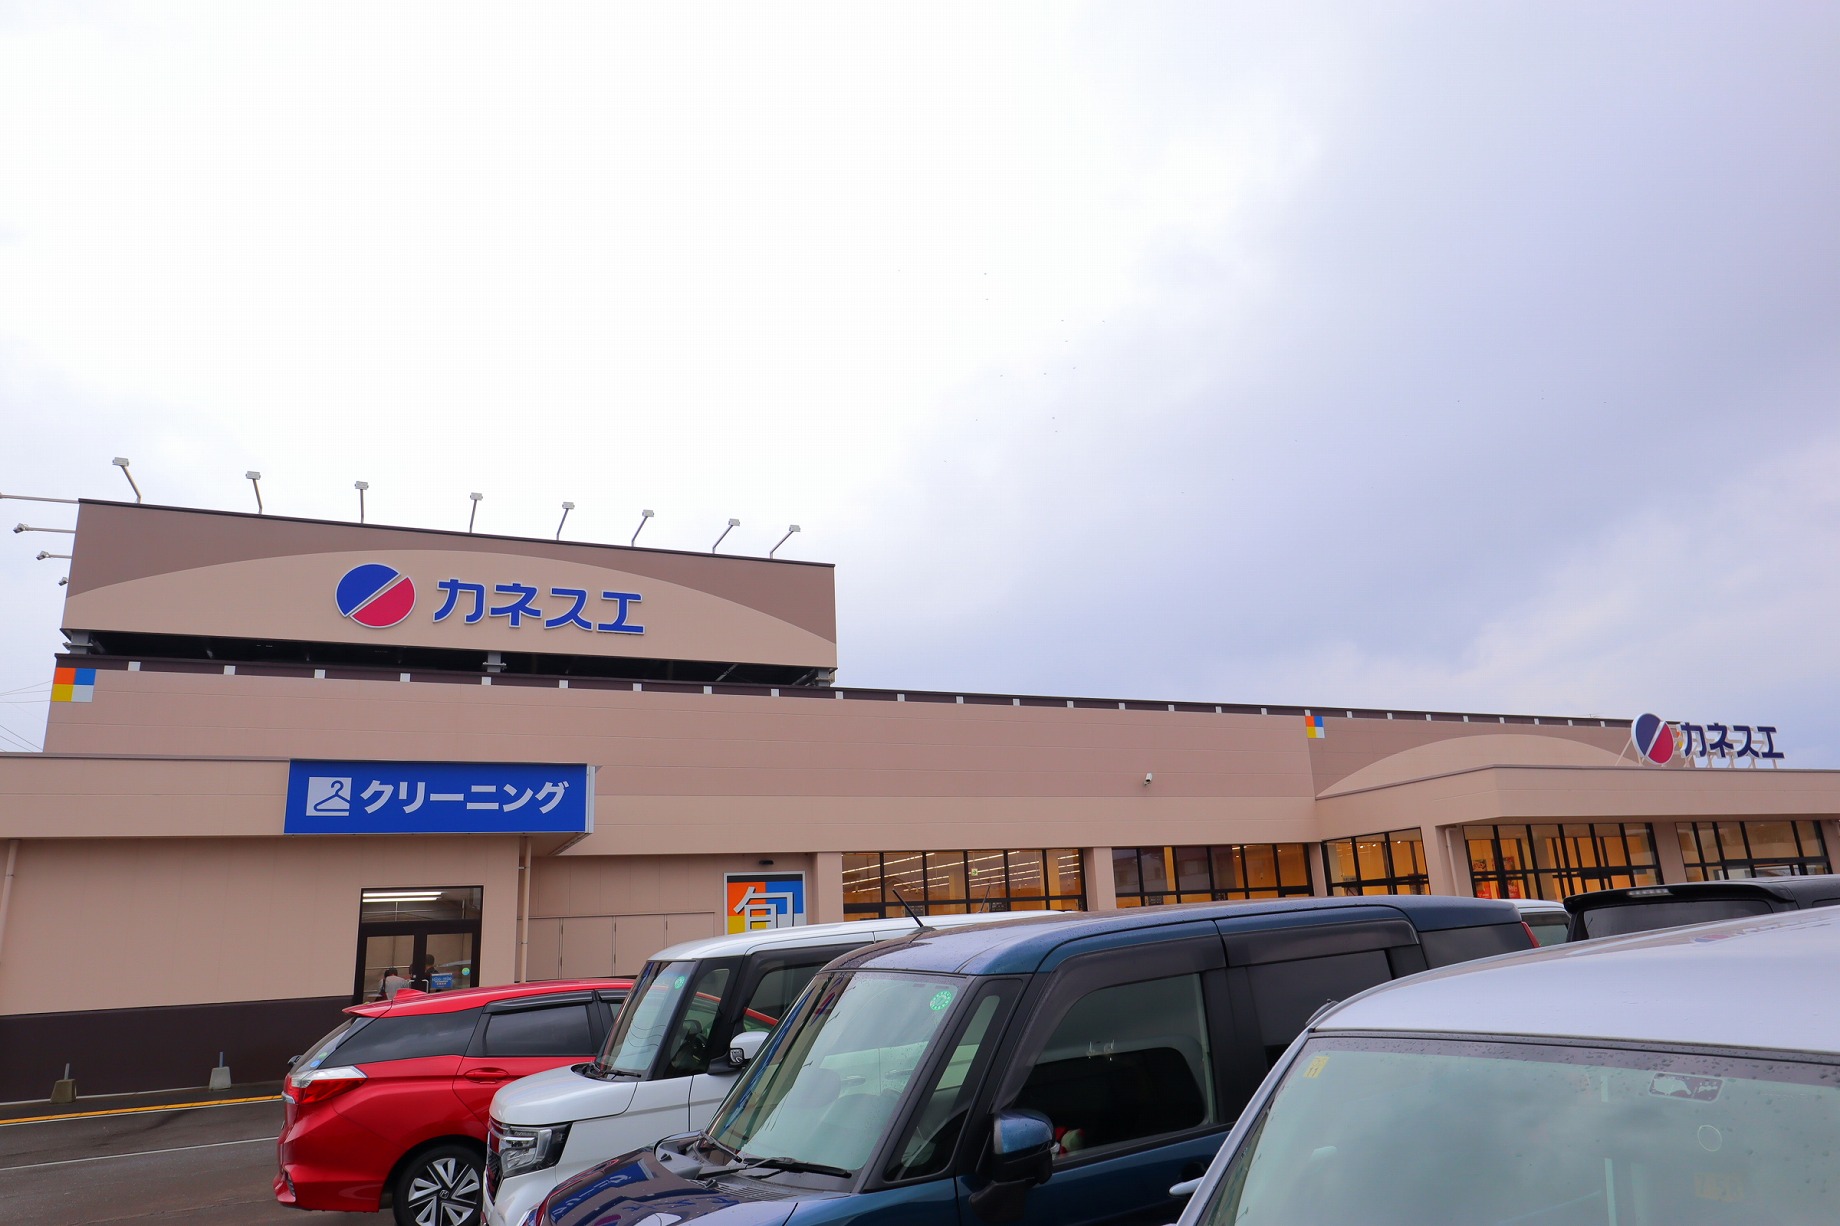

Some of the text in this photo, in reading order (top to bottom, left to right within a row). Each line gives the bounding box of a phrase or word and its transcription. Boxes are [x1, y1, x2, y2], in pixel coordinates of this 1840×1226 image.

[433, 578, 645, 635] カネスエ
[1678, 721, 1785, 759] カネスエ
[360, 779, 570, 814] クリーニング
[733, 886, 794, 931] 旬
